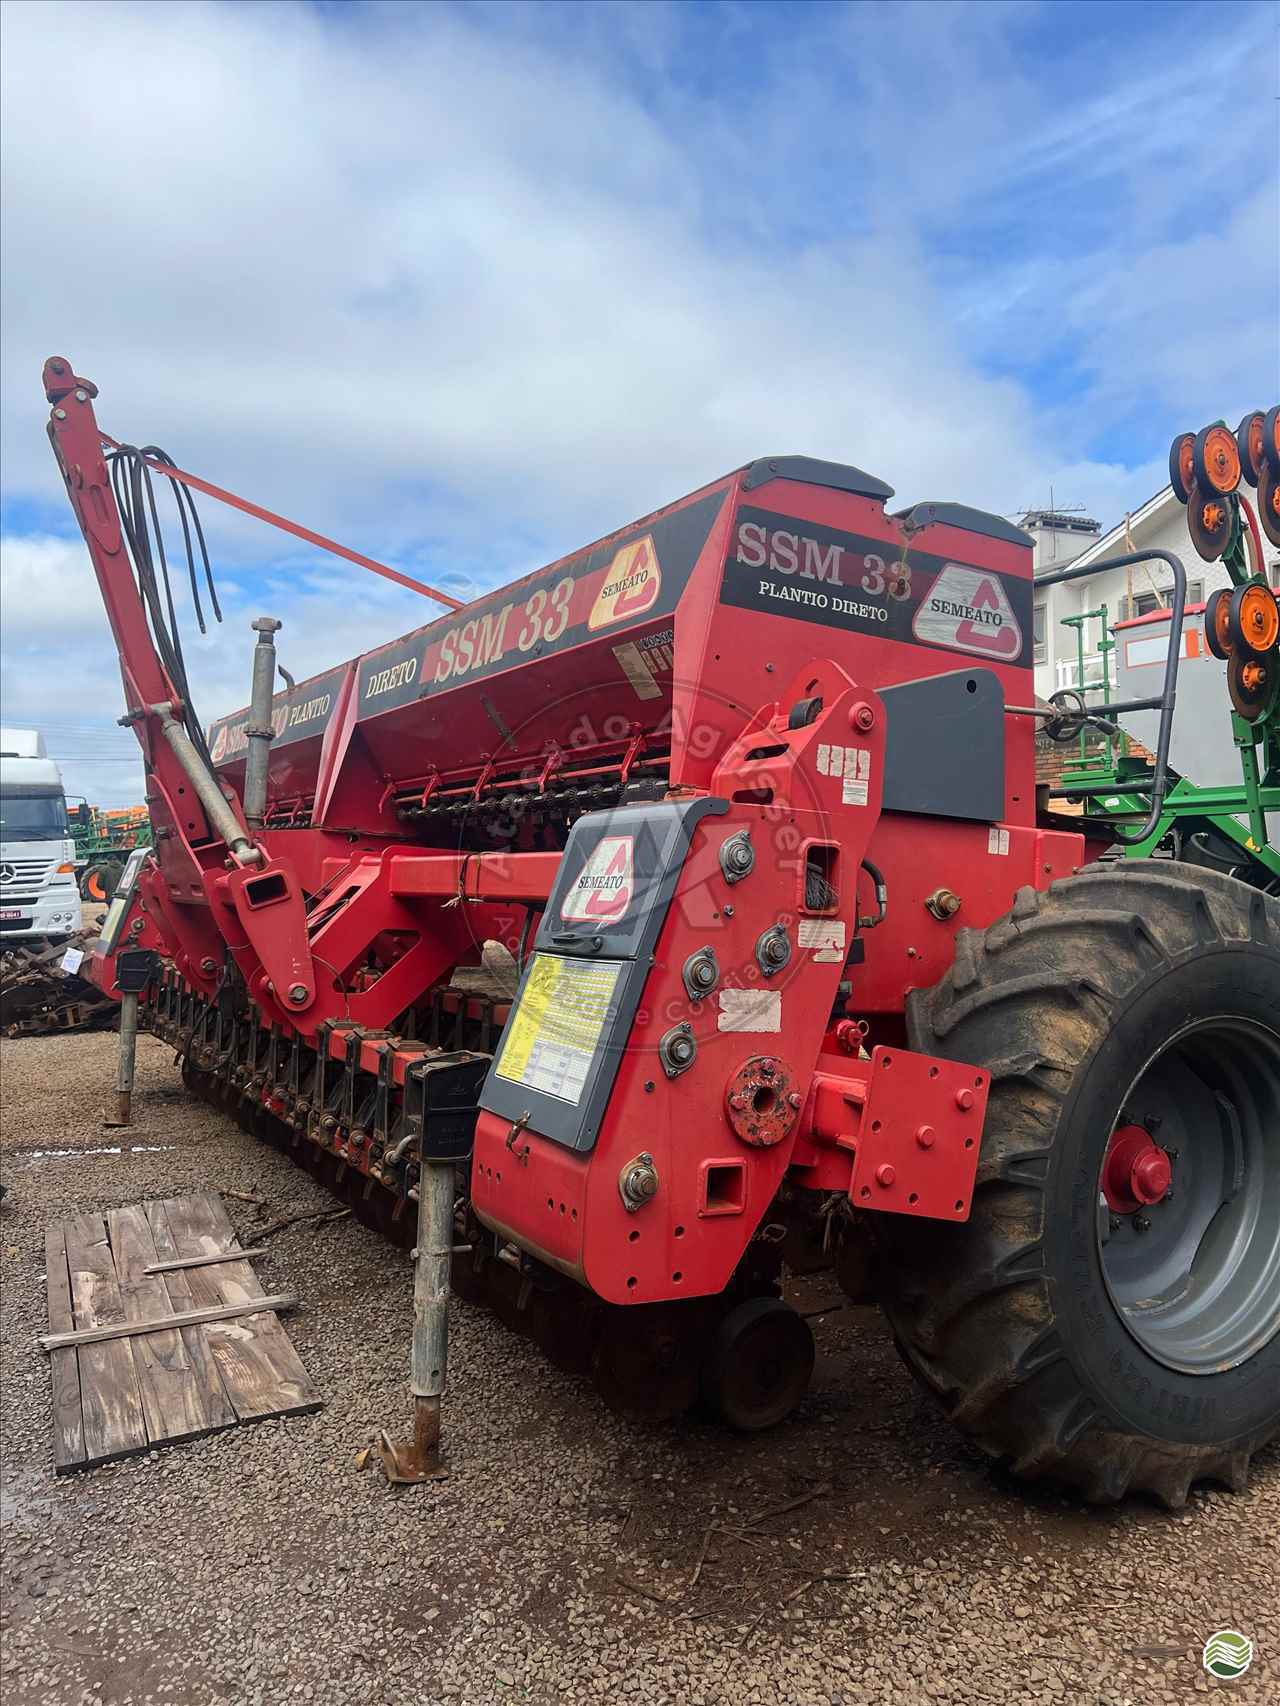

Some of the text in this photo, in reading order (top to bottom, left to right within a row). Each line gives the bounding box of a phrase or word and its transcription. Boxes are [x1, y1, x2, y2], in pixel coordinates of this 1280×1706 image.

[737, 522, 912, 601] SSM 33
[601, 570, 649, 599] SEMEATO
[758, 581, 888, 621] PLANTIO DIRETO
[434, 577, 575, 683] SSM 33
[931, 598, 1002, 626] SEMEATO
[289, 694, 330, 726] PLANTIO
[366, 657, 417, 699] DIRETO
[577, 875, 624, 889] SEMEATO
